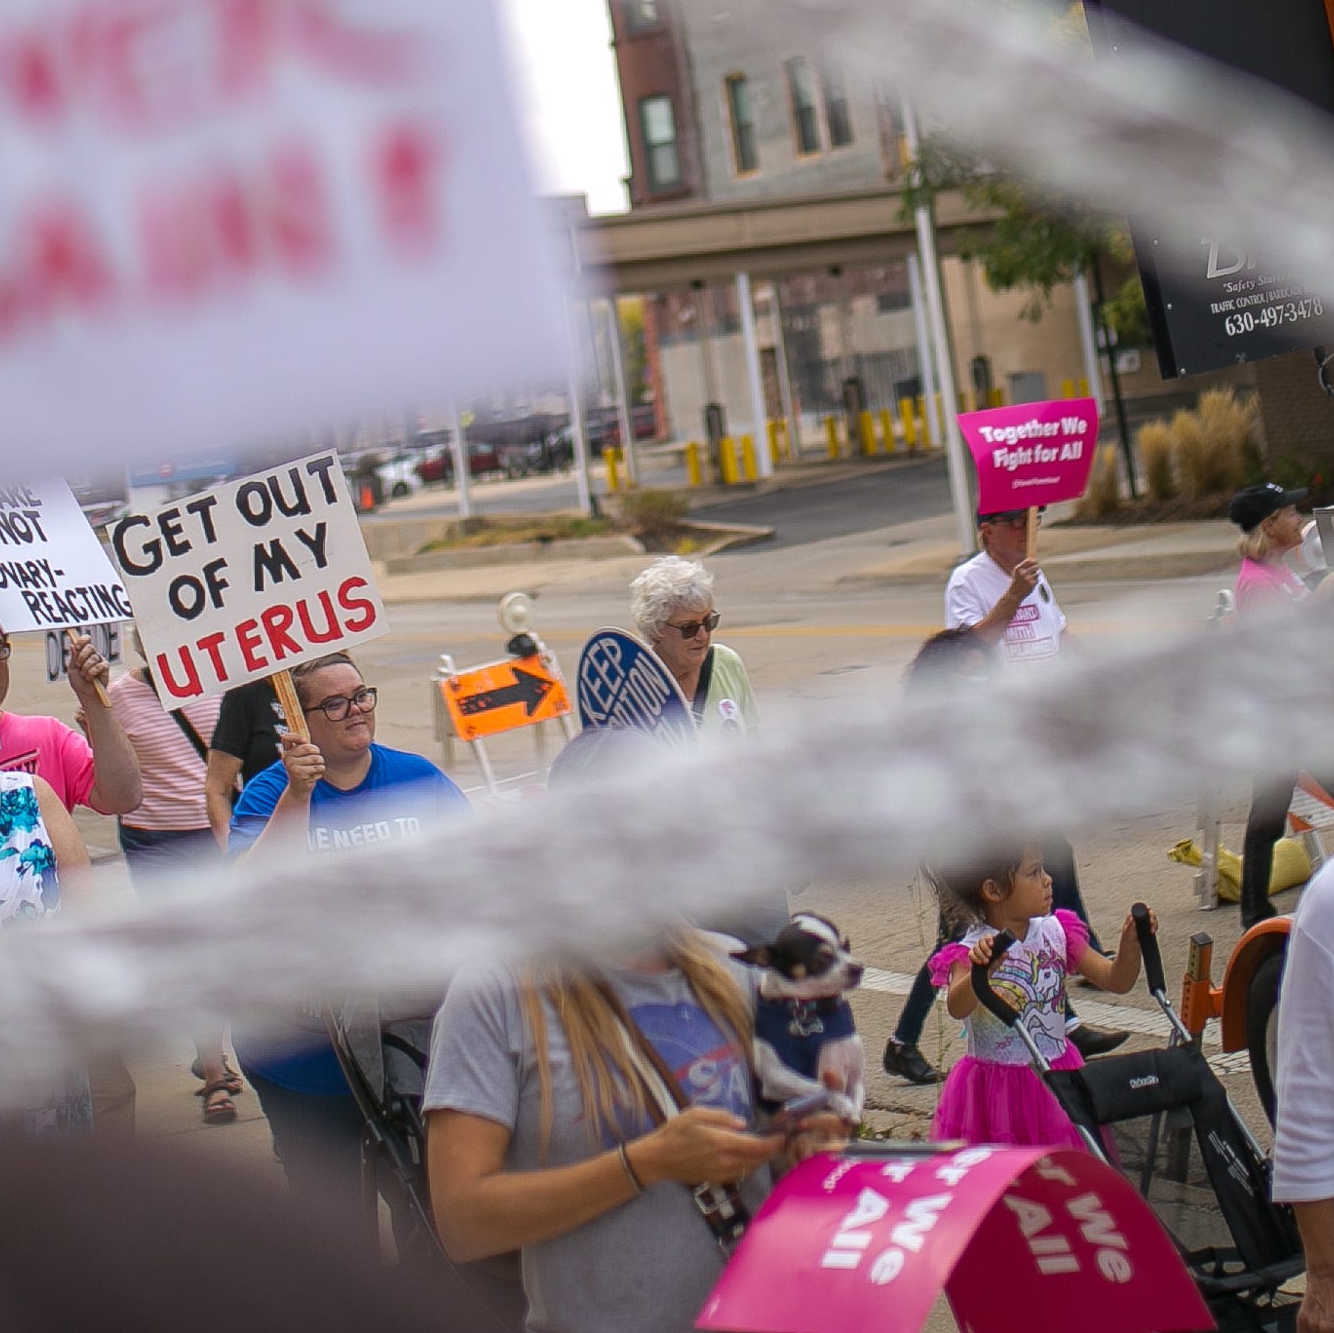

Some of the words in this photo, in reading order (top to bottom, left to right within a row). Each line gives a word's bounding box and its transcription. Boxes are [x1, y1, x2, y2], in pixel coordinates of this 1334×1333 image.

[1210, 299, 1235, 314] TRAFFIC
[1225, 296, 1323, 337] 630-497-3478
[979, 419, 1060, 445] Together
[1061, 416, 1087, 435] We
[993, 447, 1032, 472] Fight
[1034, 443, 1059, 463] for
[1059, 441, 1083, 461] All
[112, 495, 217, 576] GET
[236, 456, 338, 526] OUT
[21, 584, 134, 626] REACTING
[168, 557, 229, 621] OF
[253, 522, 328, 592] MY
[156, 576, 377, 698] UTERUS
[580, 637, 626, 728] KEEP
[332, 821, 391, 848] NEED
[395, 817, 419, 835] TO
[821, 1187, 889, 1269] All
[871, 1193, 953, 1285] We
[1003, 1194, 1081, 1275] All
[1066, 1192, 1132, 1284] We
